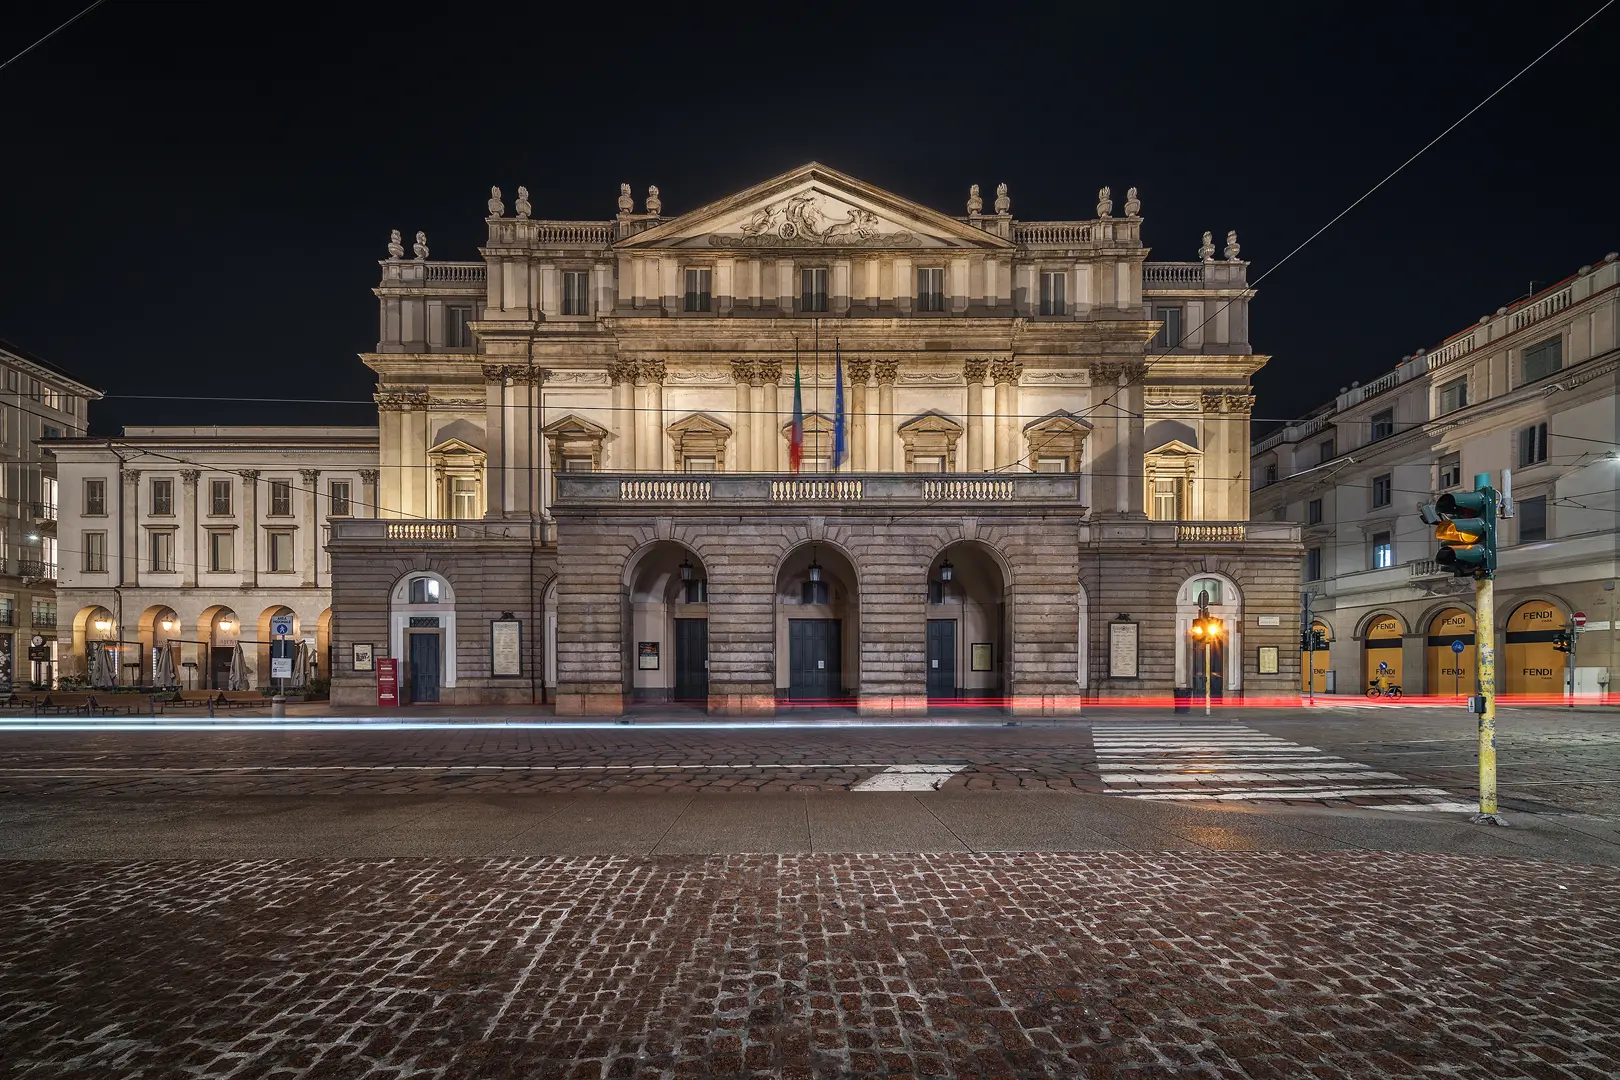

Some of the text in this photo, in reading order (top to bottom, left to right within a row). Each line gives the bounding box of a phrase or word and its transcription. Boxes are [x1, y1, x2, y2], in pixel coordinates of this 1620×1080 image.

[1523, 611, 1553, 620] FENDI
[1441, 617, 1466, 625] FENDI
[1376, 622, 1396, 630] FENDI
[1523, 668, 1552, 676] FENDI
